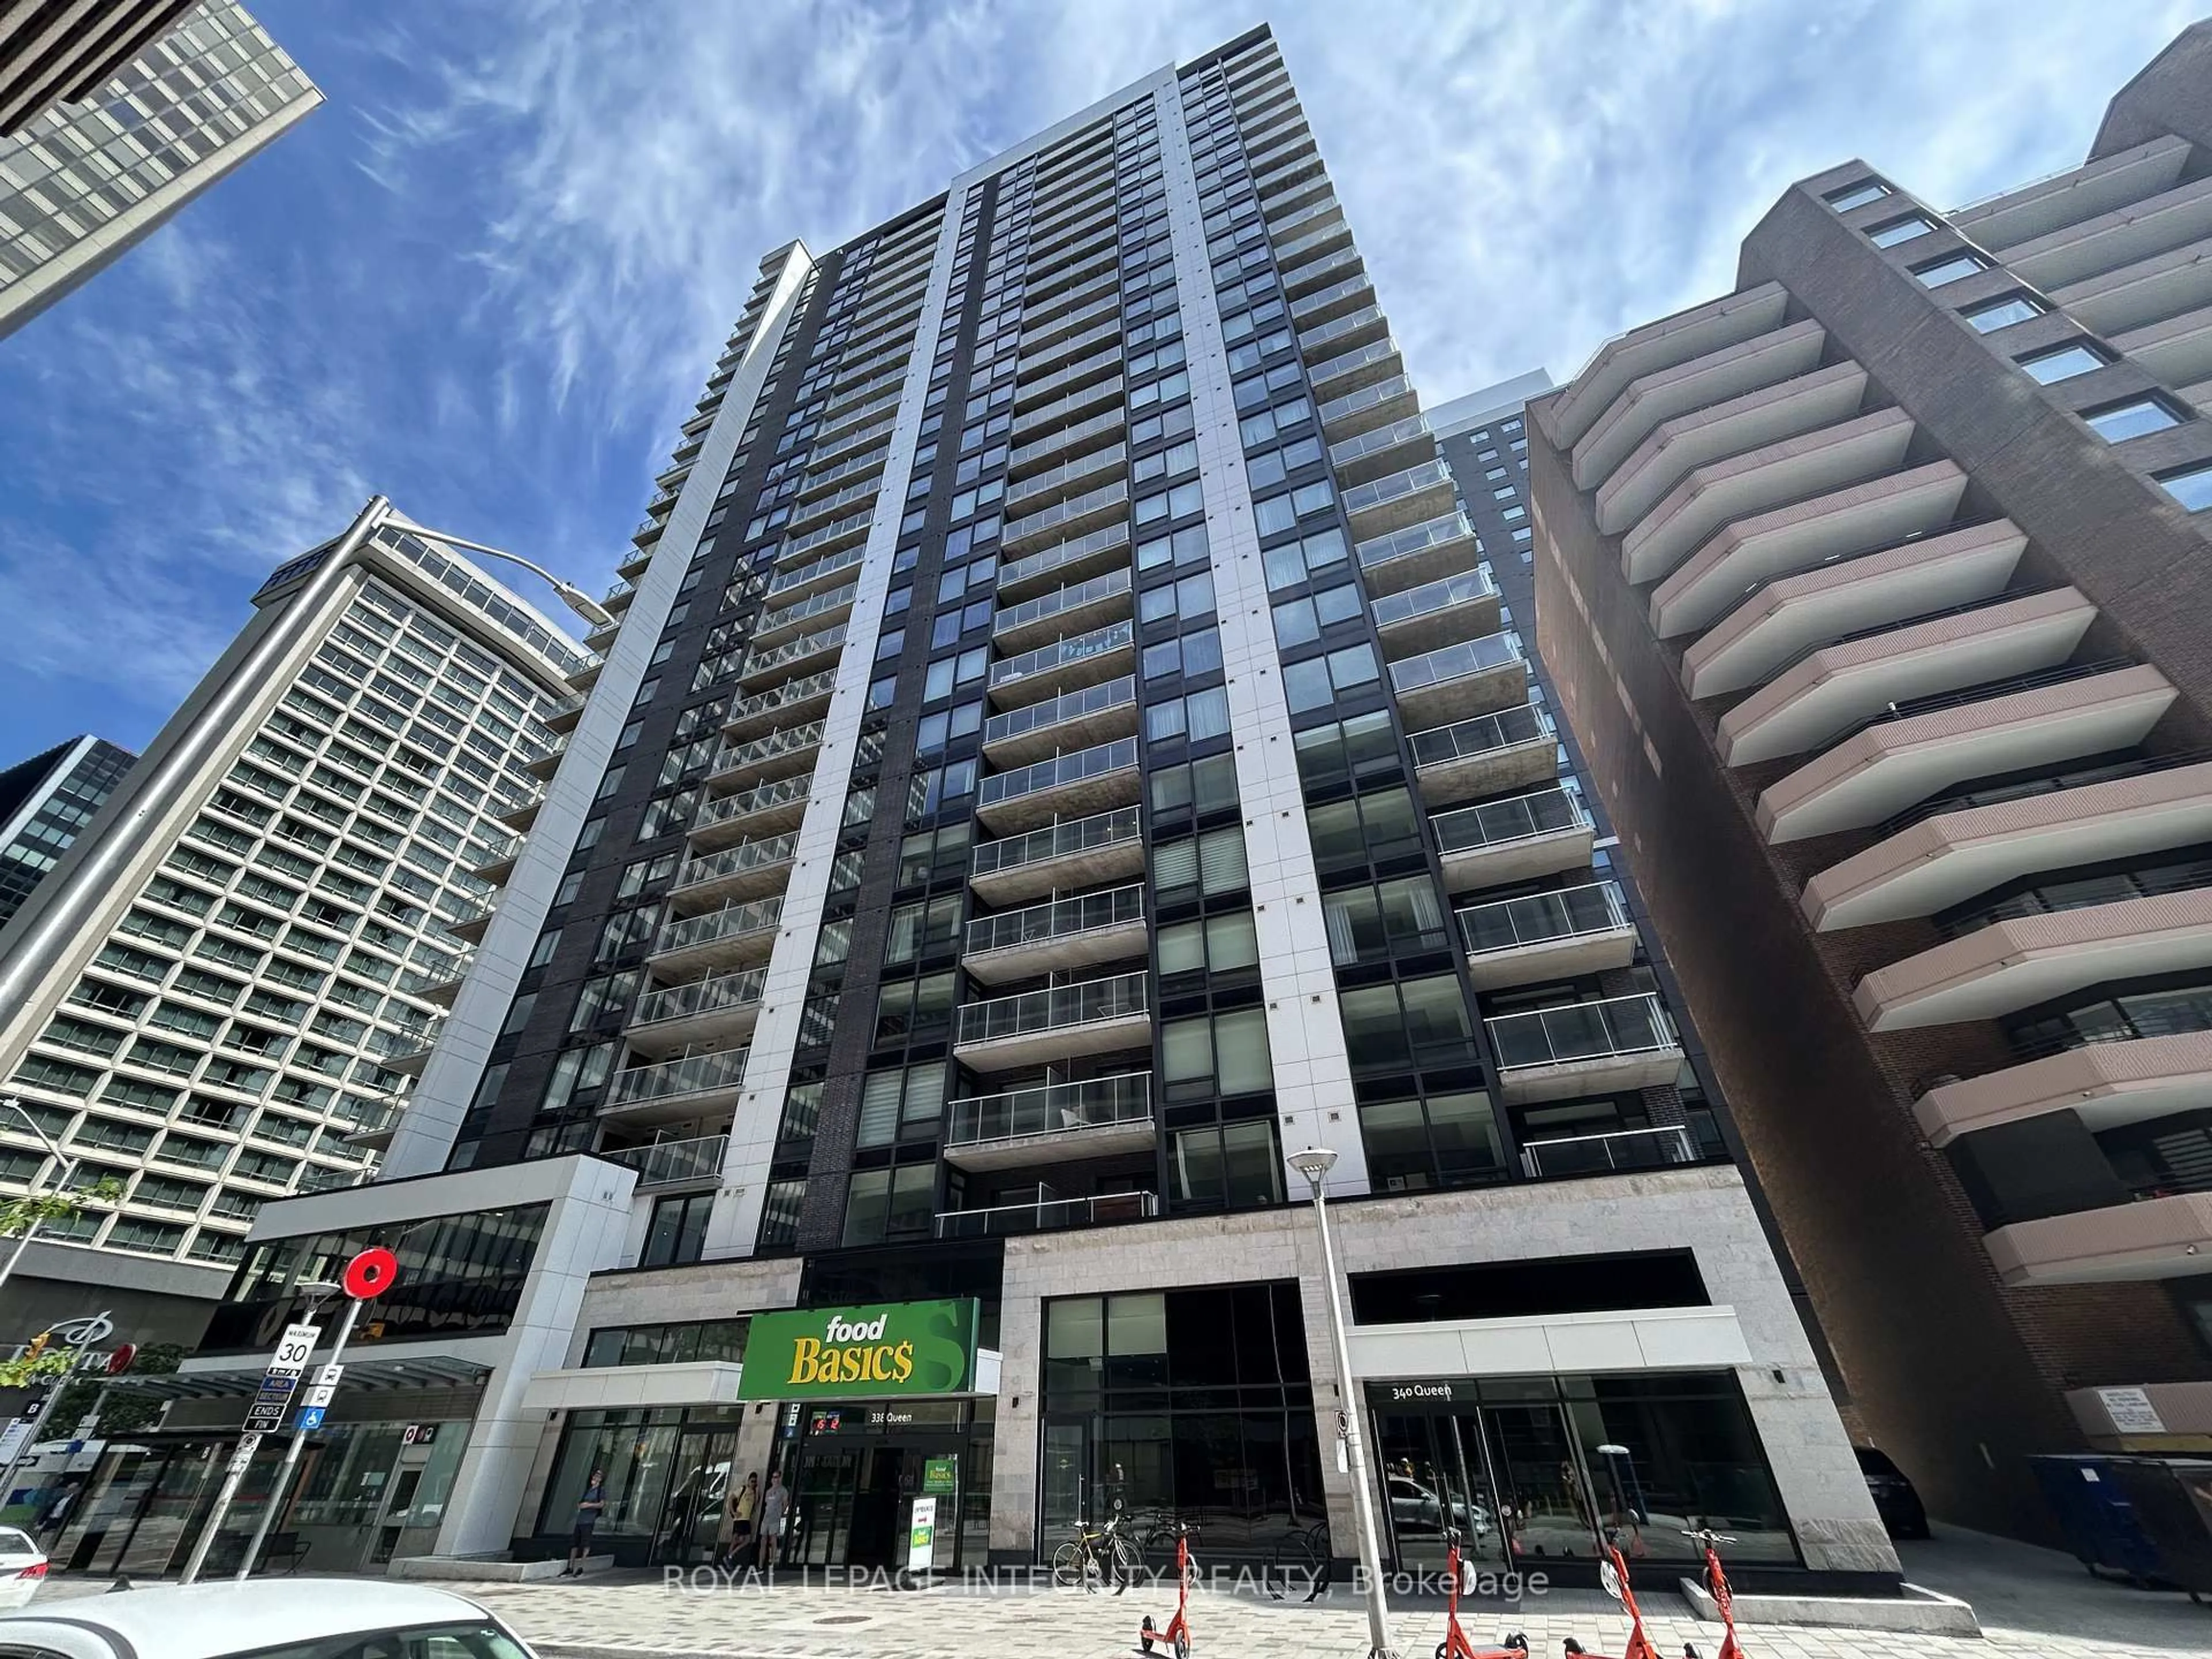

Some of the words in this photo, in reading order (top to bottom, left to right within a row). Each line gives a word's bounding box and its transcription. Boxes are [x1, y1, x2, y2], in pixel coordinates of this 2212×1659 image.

[825, 1314, 888, 1343] food
[279, 1343, 307, 1362] 30
[1392, 1387, 1412, 1400] 340
[1414, 1384, 1452, 1396] Queen
[28, 1403, 40, 1414] B
[254, 1406, 279, 1416] ENDS
[887, 1412, 912, 1422] Queen
[254, 1419, 269, 1429] FIN
